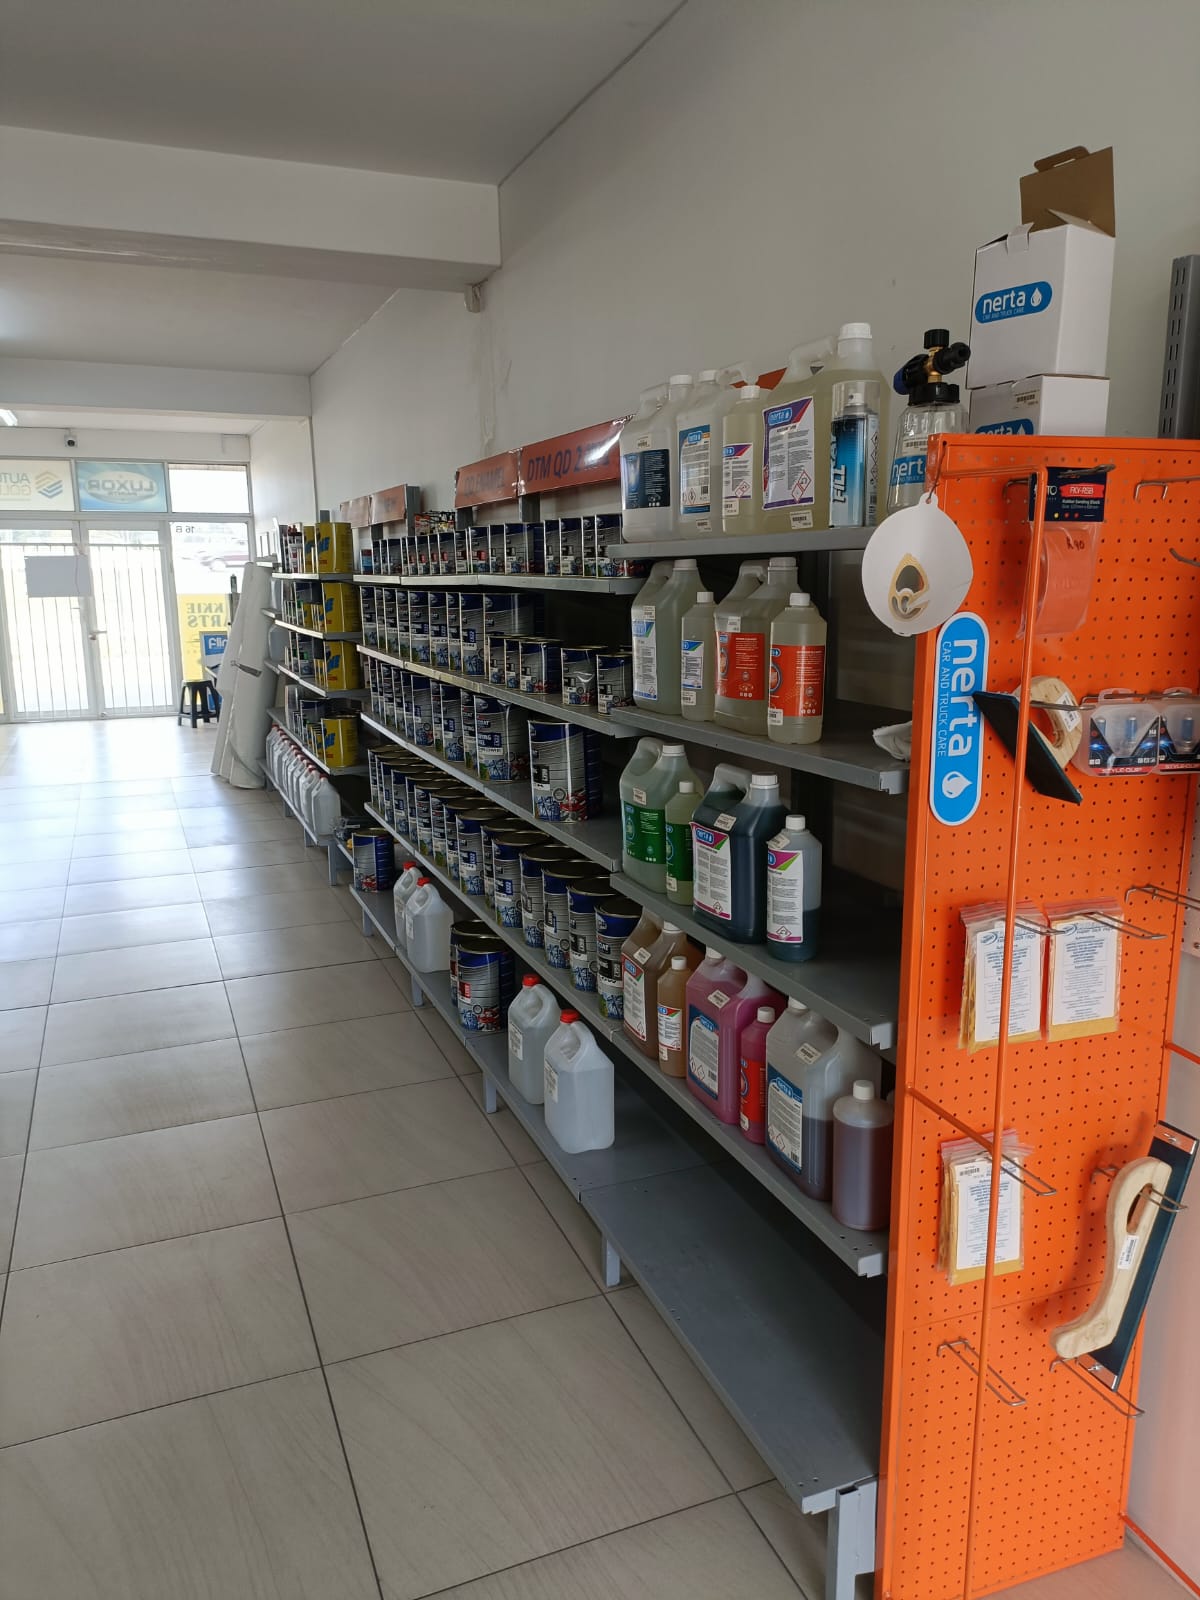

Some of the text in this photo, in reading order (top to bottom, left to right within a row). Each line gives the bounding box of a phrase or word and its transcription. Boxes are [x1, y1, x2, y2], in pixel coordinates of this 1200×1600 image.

[982, 289, 1026, 314] nerta
[527, 454, 552, 481] DTM
[554, 449, 571, 479] QD
[892, 458, 927, 477] nert
[936, 641, 951, 757] CAR AND TRUCK CARE
[948, 639, 978, 757] nerta
